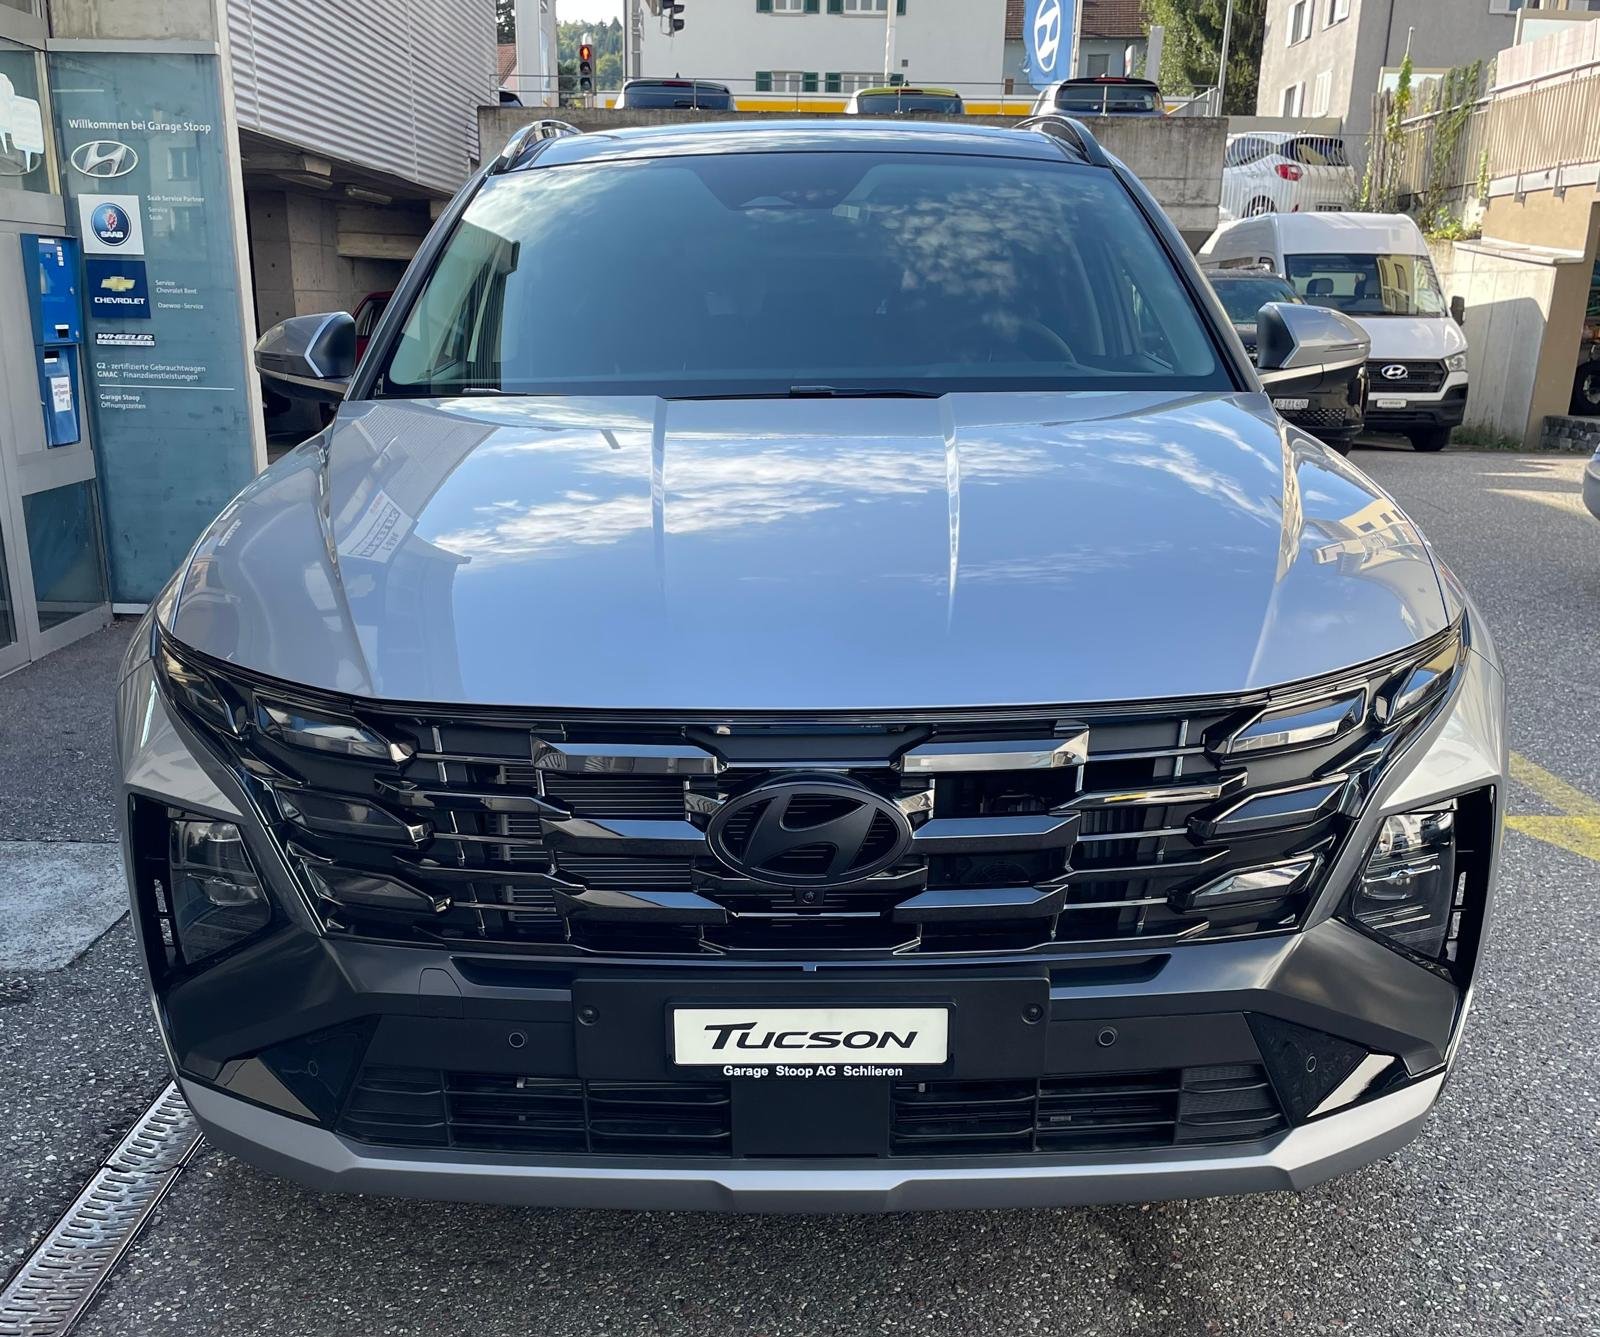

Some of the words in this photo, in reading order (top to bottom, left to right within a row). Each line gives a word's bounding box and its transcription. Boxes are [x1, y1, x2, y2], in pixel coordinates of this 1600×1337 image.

[68, 120, 129, 130] Willkommen
[131, 120, 146, 130] bei
[148, 121, 182, 133] Garage
[183, 122, 211, 134] Stoop
[94, 296, 145, 305] CHEVROLET
[97, 333, 153, 341] WHEELER
[150, 364, 206, 373] Gebrauchtwagen
[123, 372, 198, 381] Finanzdienstleistungen
[122, 394, 140, 402] Stoop
[723, 1065, 769, 1079] Garage
[776, 1065, 813, 1079] Stoop
[815, 1065, 836, 1077] AG
[843, 1065, 903, 1077] Schlieren
